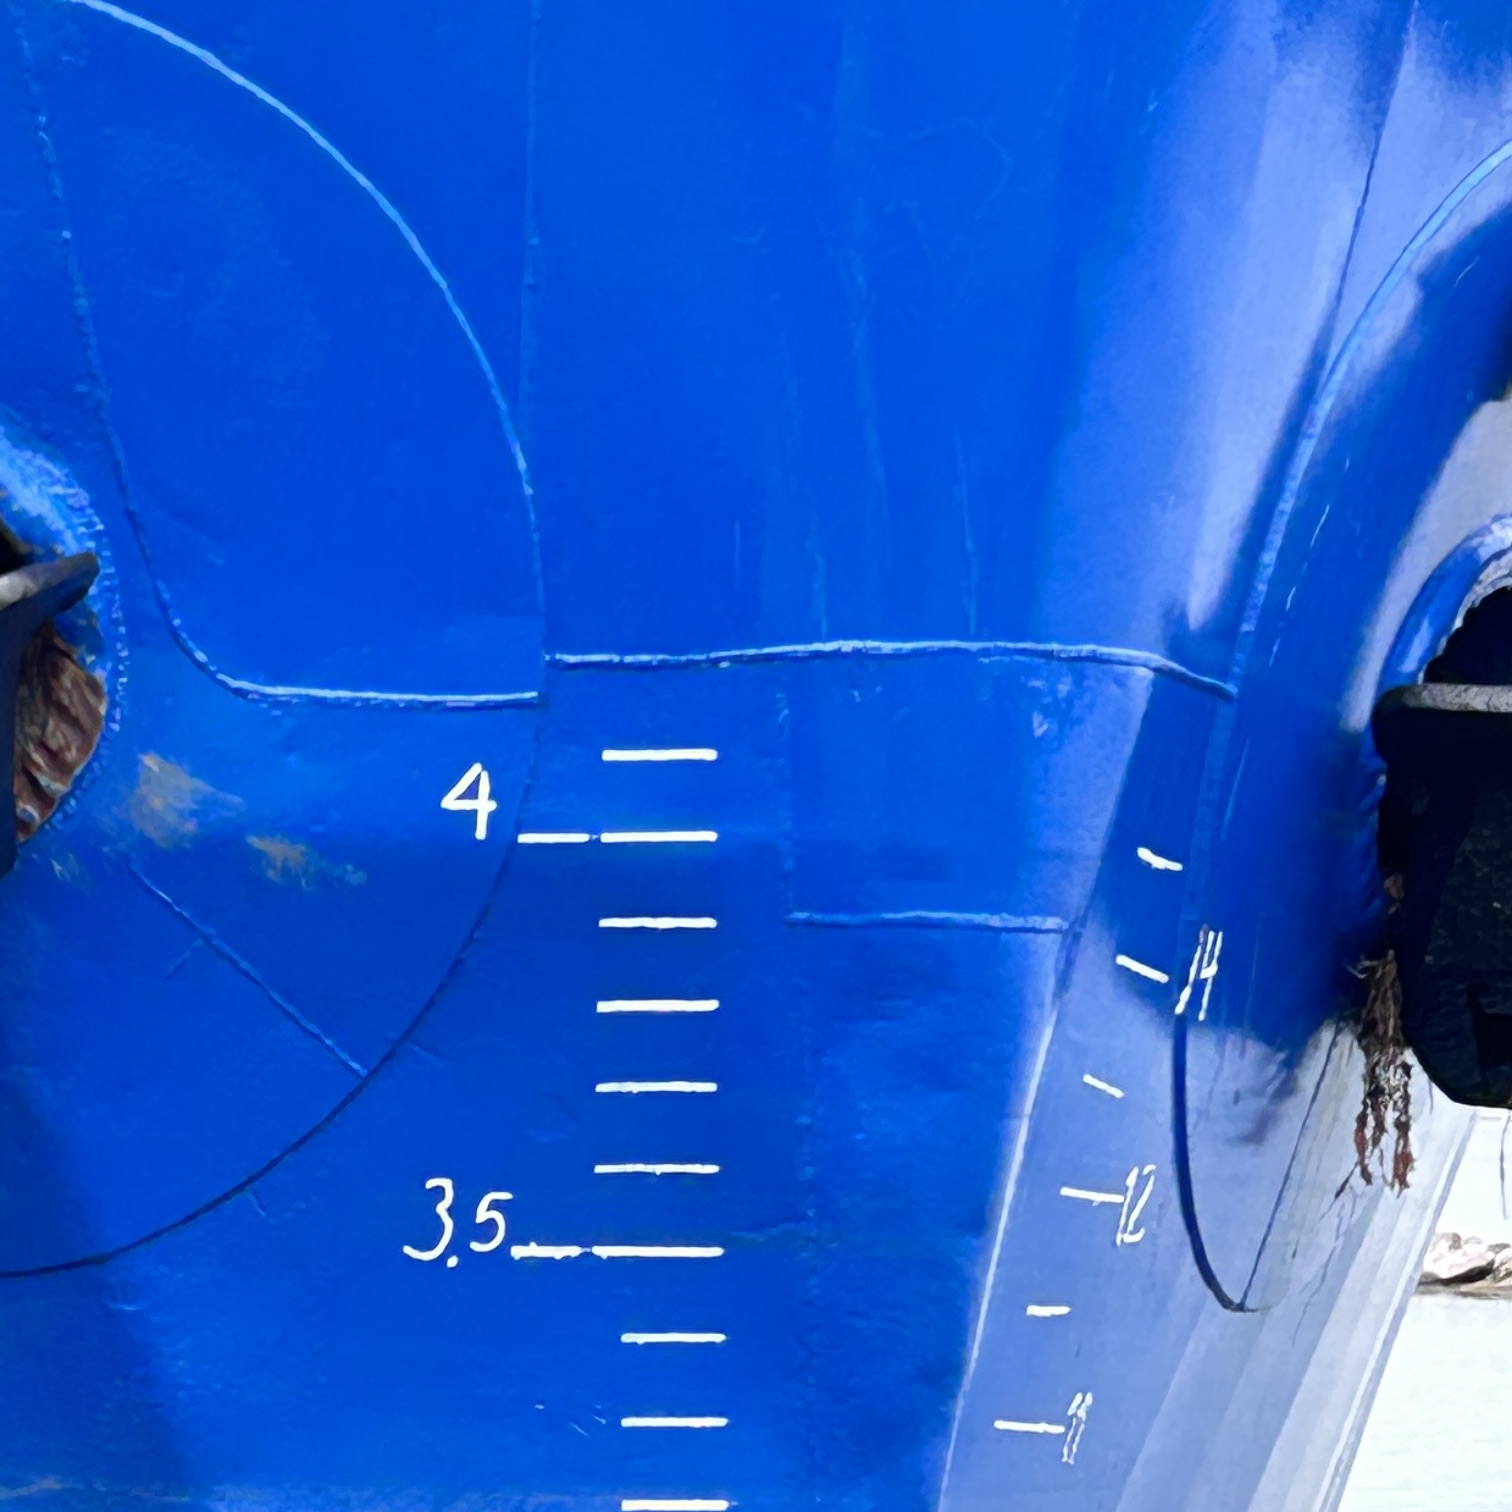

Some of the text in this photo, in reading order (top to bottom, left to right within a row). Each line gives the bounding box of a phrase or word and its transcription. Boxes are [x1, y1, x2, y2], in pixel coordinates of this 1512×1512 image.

[440, 763, 498, 840] 4
[403, 1178, 513, 1268] 3.5
[1116, 1164, 1157, 1247] 12
